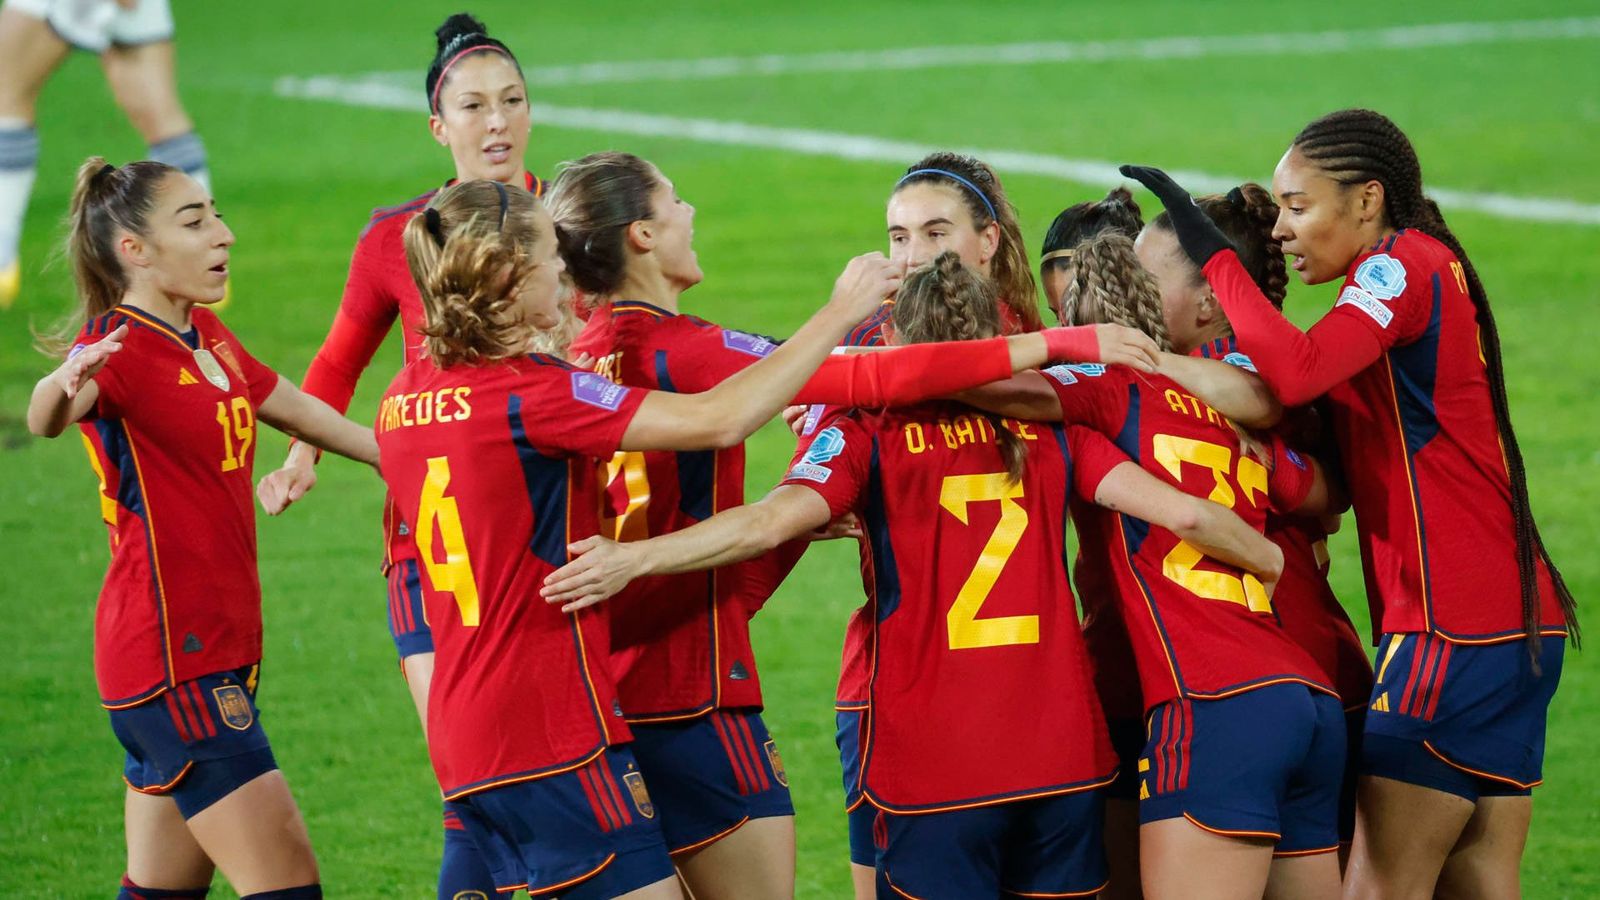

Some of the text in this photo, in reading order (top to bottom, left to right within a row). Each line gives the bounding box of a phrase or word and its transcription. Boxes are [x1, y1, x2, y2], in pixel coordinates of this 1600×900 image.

[216, 396, 254, 473] 19
[379, 386, 472, 434] PAREDES
[415, 455, 480, 628] 4
[939, 471, 1040, 650] 2
